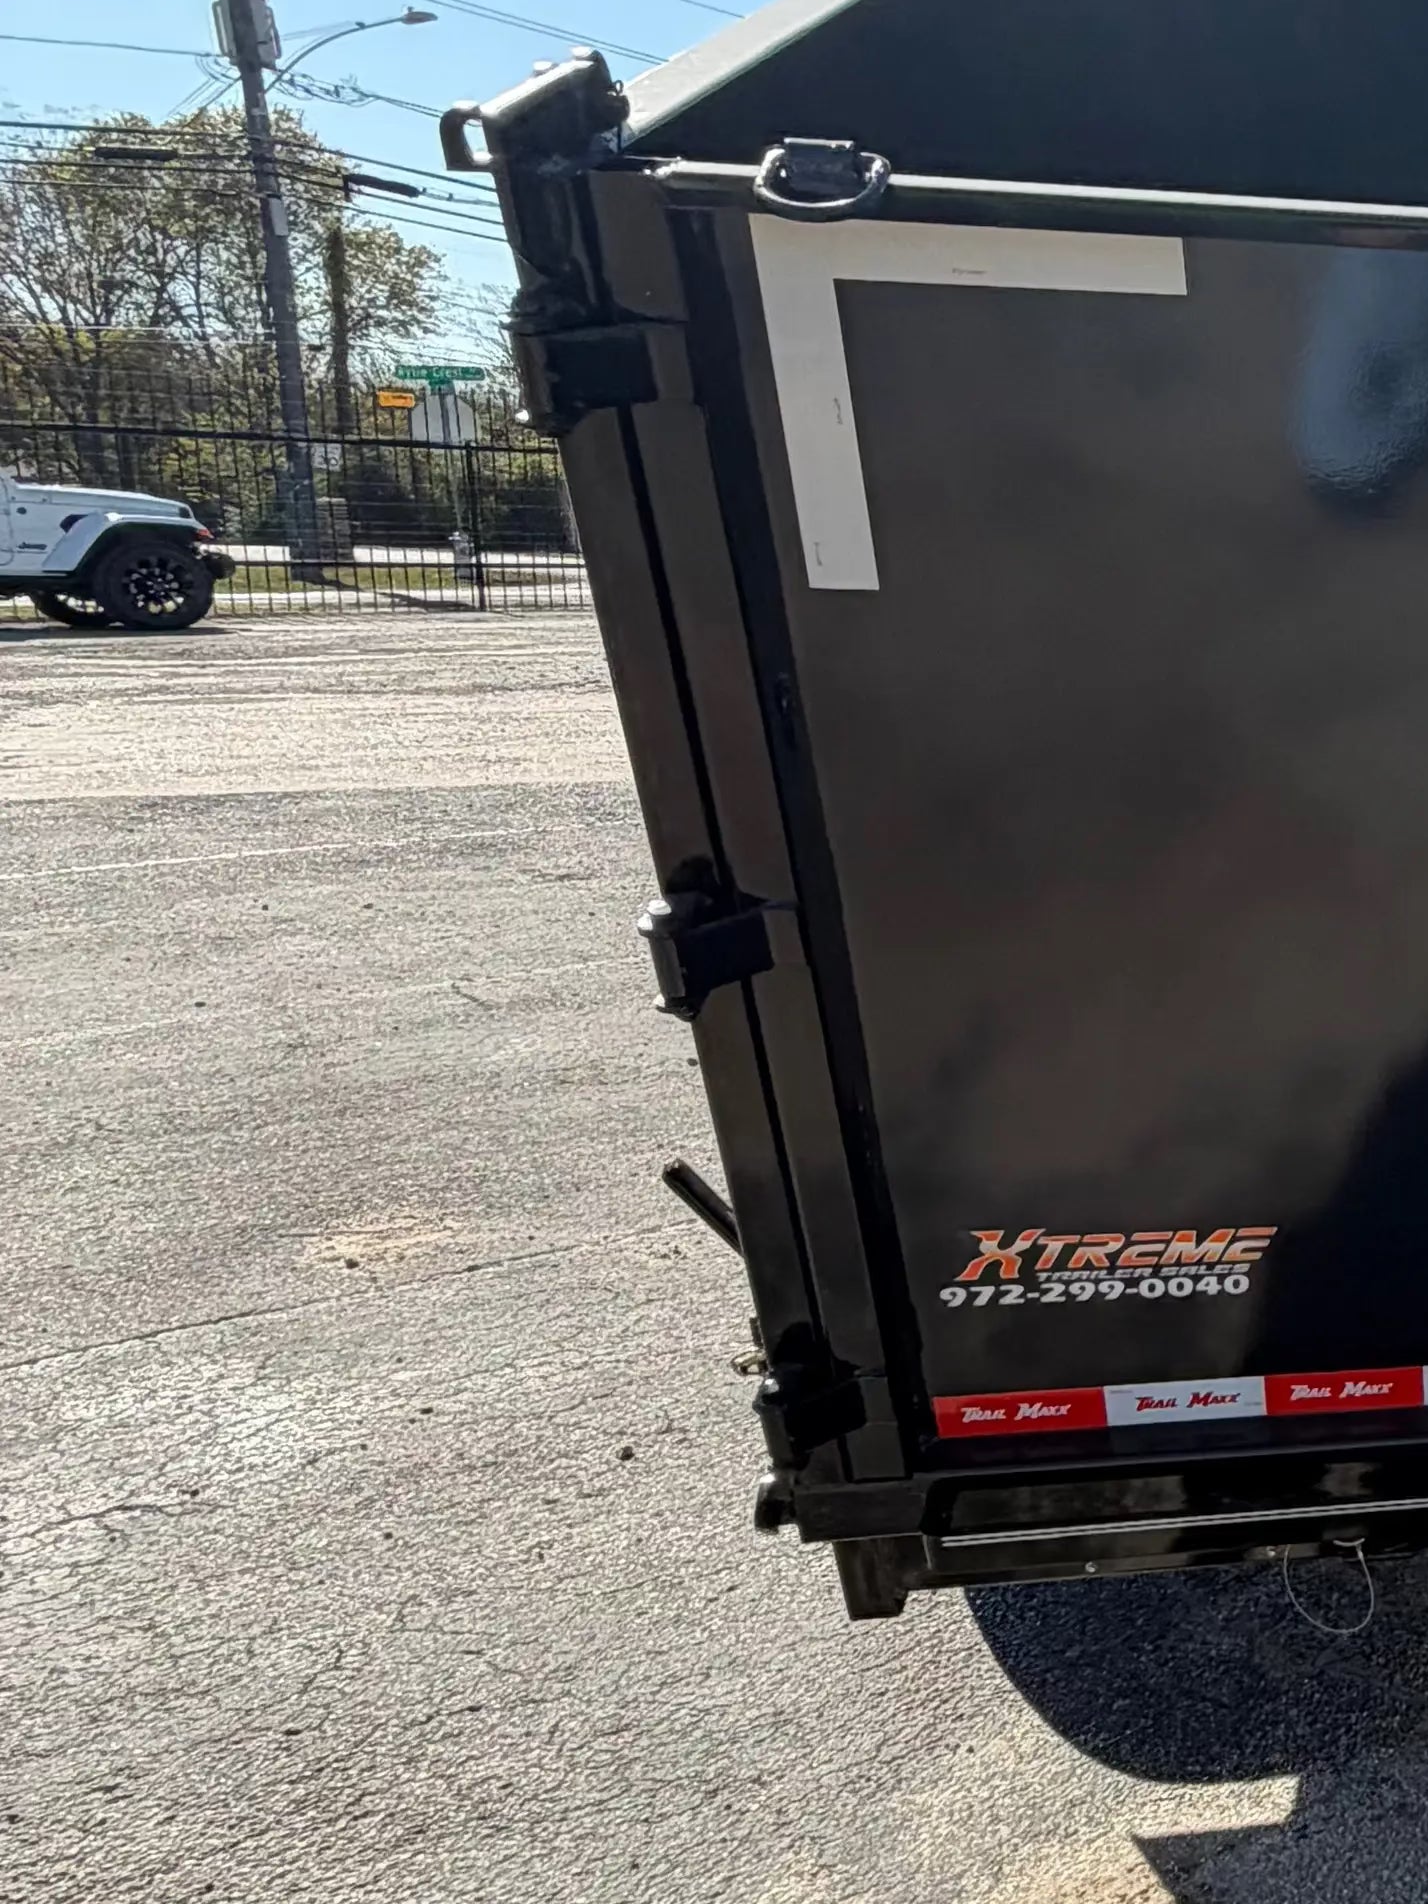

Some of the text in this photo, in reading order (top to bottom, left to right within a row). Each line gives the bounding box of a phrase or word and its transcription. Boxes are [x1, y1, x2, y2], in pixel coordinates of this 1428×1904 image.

[952, 1226, 1279, 1282] XTREME
[1035, 1263, 1251, 1281] TRAILER SALES
[938, 1274, 1251, 1308] 972-299-0040
